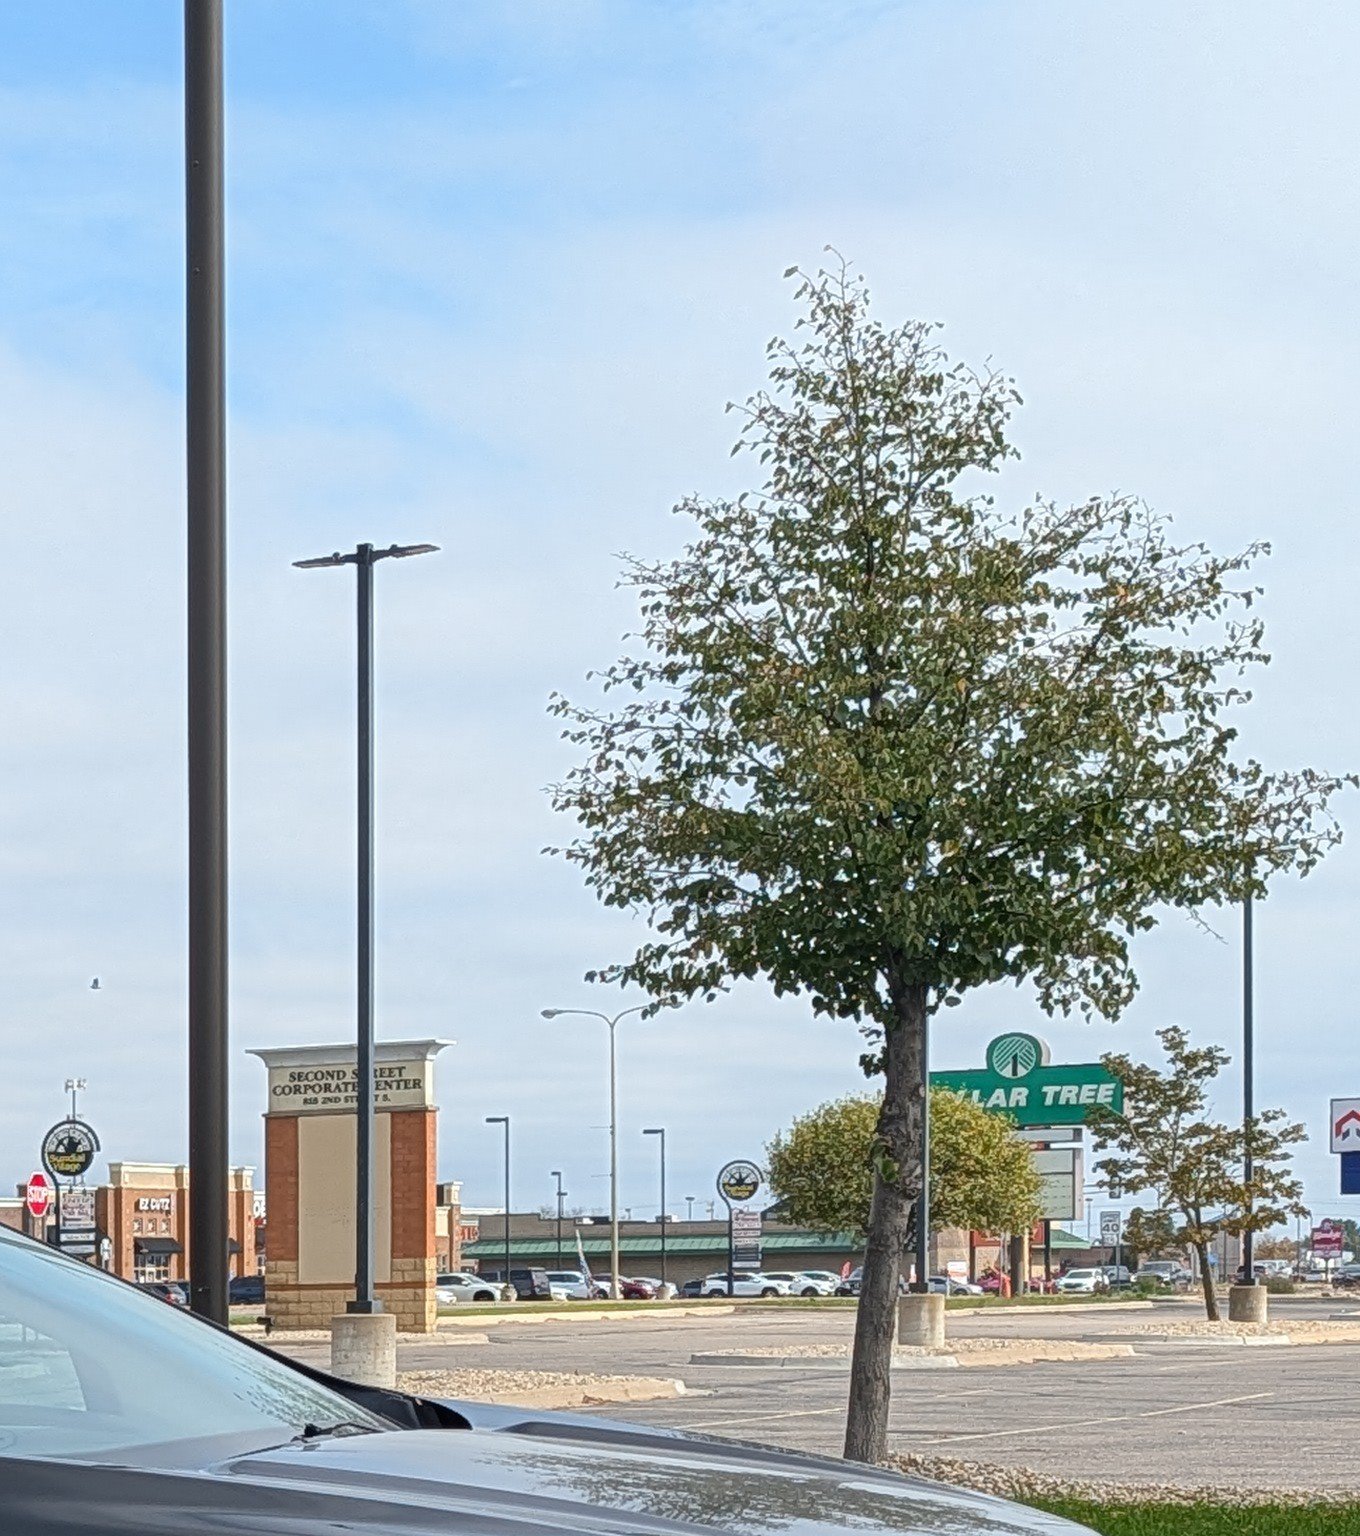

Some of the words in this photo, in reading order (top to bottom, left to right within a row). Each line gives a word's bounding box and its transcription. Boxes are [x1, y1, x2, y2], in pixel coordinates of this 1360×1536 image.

[288, 1069, 347, 1083] SECOND
[351, 1066, 406, 1080] SEET
[374, 1078, 422, 1091] ENTER
[1041, 1082, 1117, 1106] TREE
[29, 1188, 48, 1202] STOP
[1102, 1223, 1120, 1232] 40
